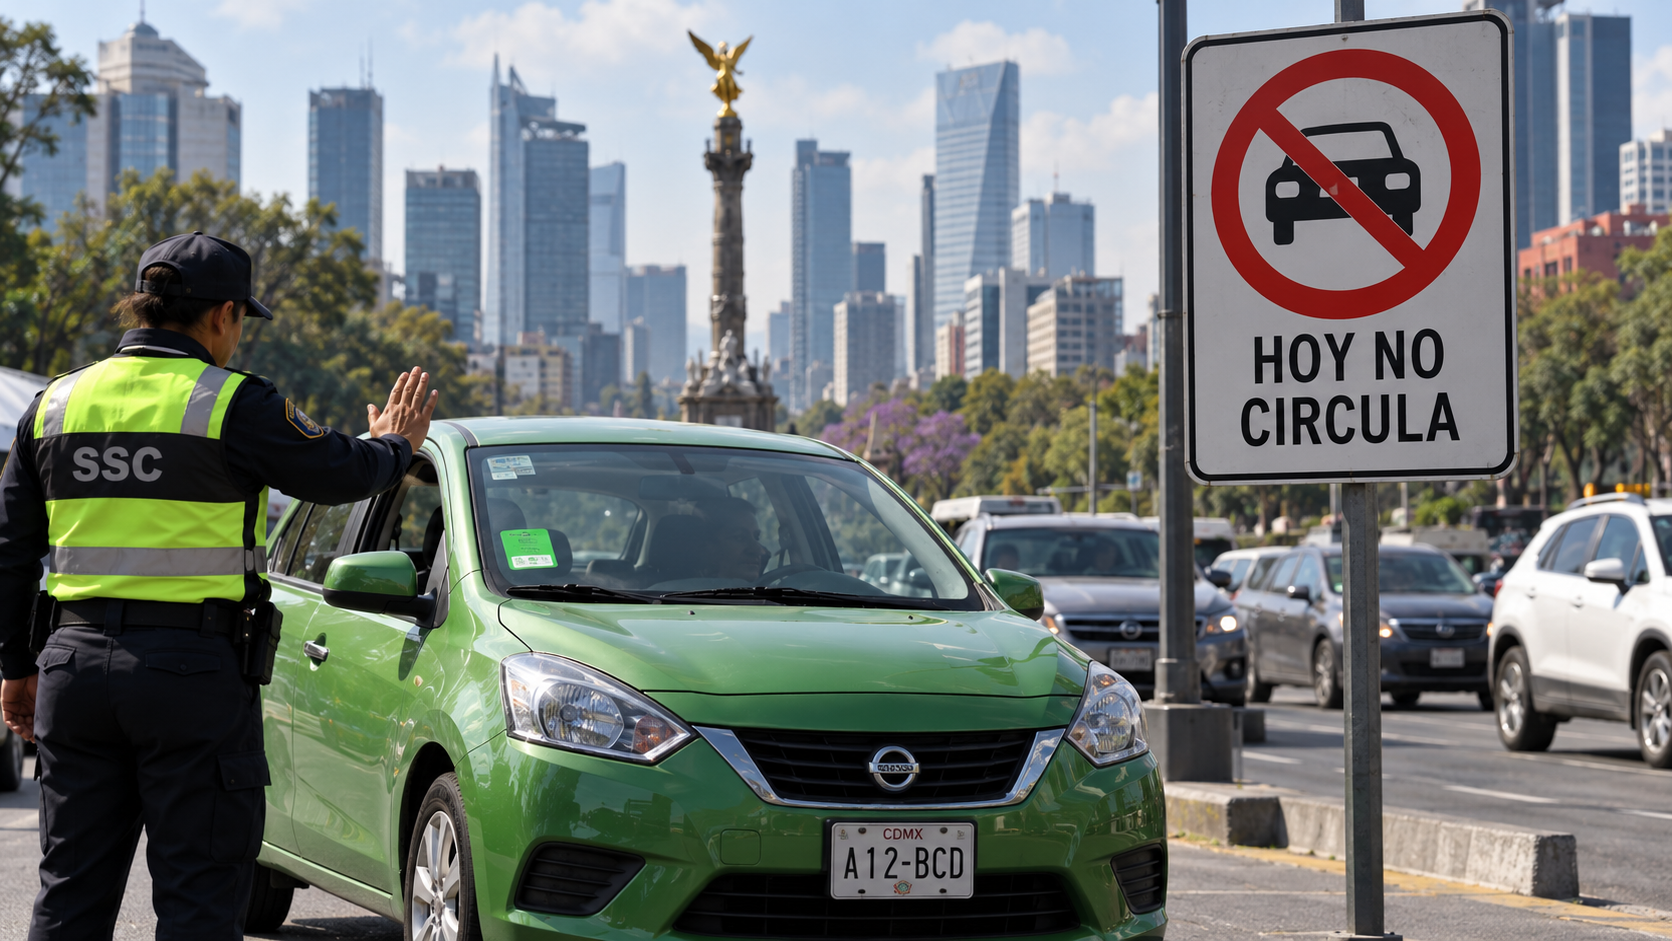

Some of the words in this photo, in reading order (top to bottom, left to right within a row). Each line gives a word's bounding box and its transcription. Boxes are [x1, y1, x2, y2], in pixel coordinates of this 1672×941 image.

[1254, 332, 1355, 384] HOY
[1375, 328, 1444, 380] NO
[1240, 392, 1460, 447] CIRCULA
[72, 446, 163, 482] SSC
[883, 828, 923, 840] CDMX
[843, 847, 964, 879] A12-BCD
